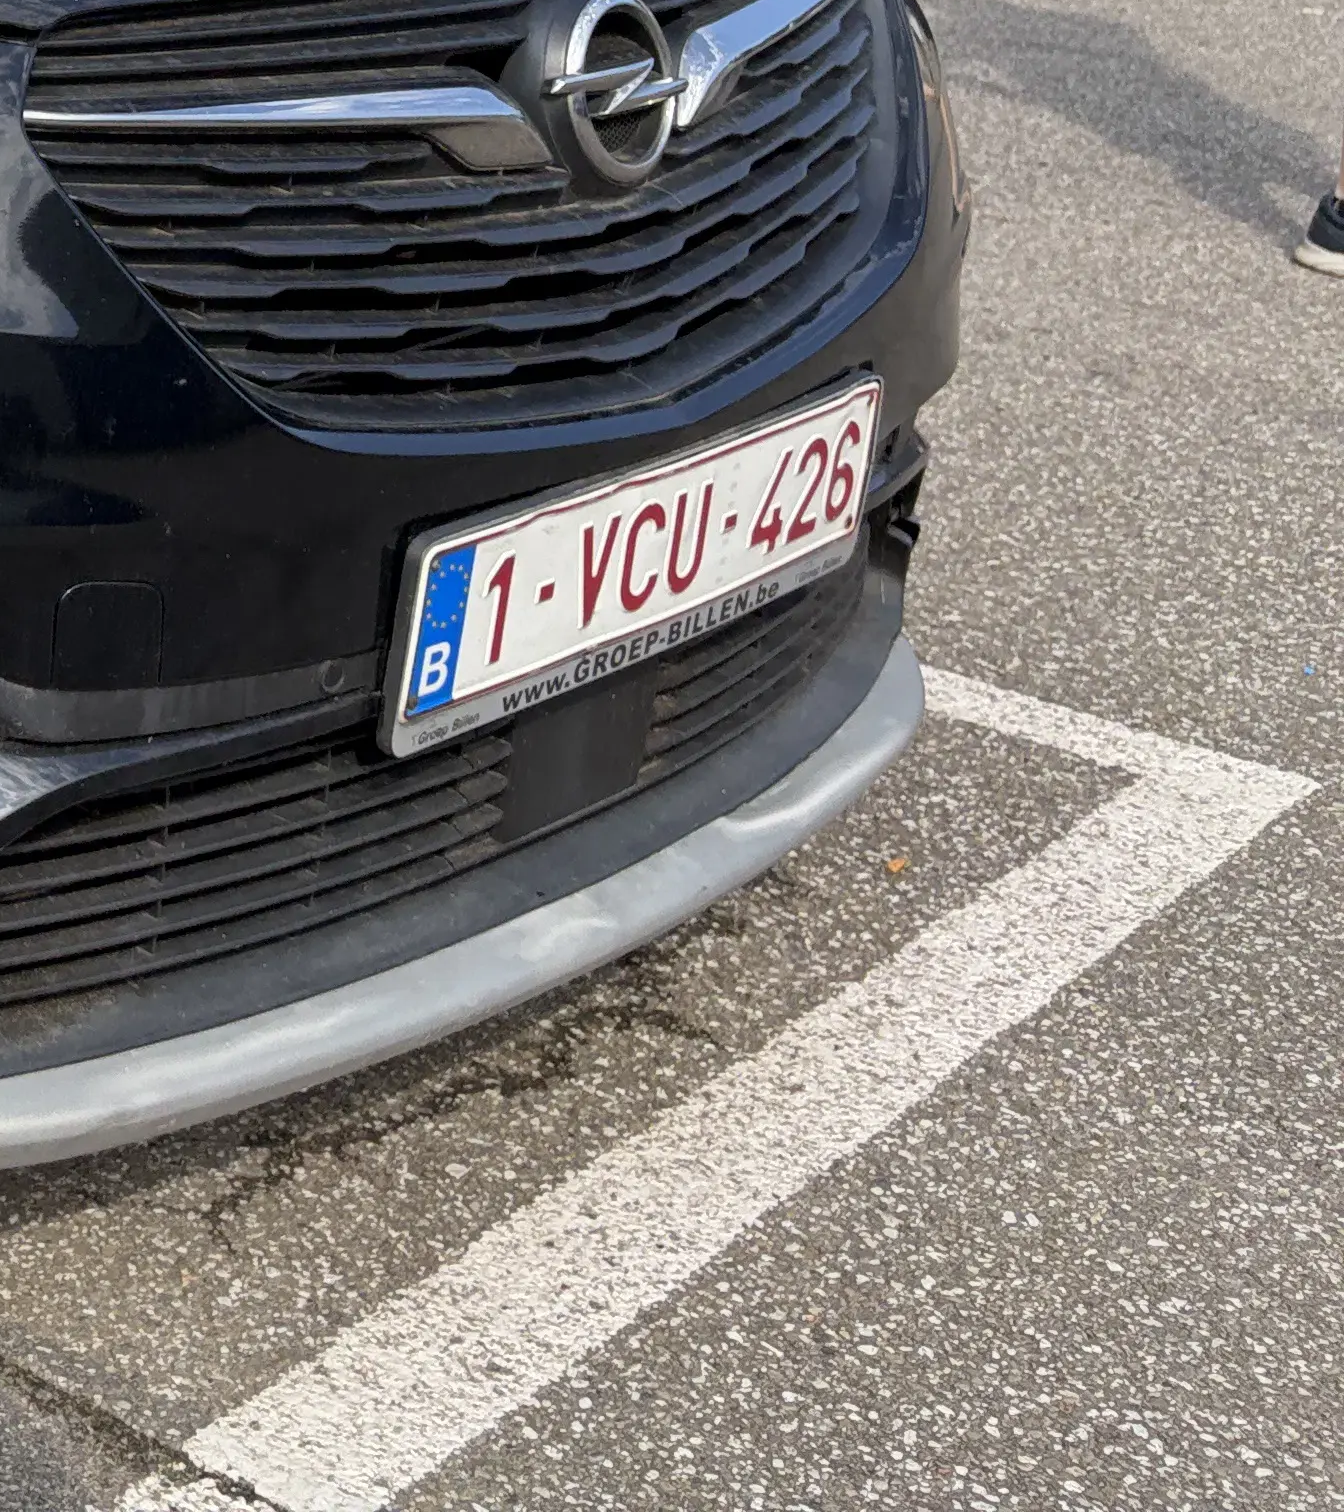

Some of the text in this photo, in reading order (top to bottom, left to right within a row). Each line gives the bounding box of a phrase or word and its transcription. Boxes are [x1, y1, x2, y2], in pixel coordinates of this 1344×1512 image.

[418, 419, 862, 697] B 1-VCU-426
[500, 581, 780, 714] www.GROEP-BILLEN.be
